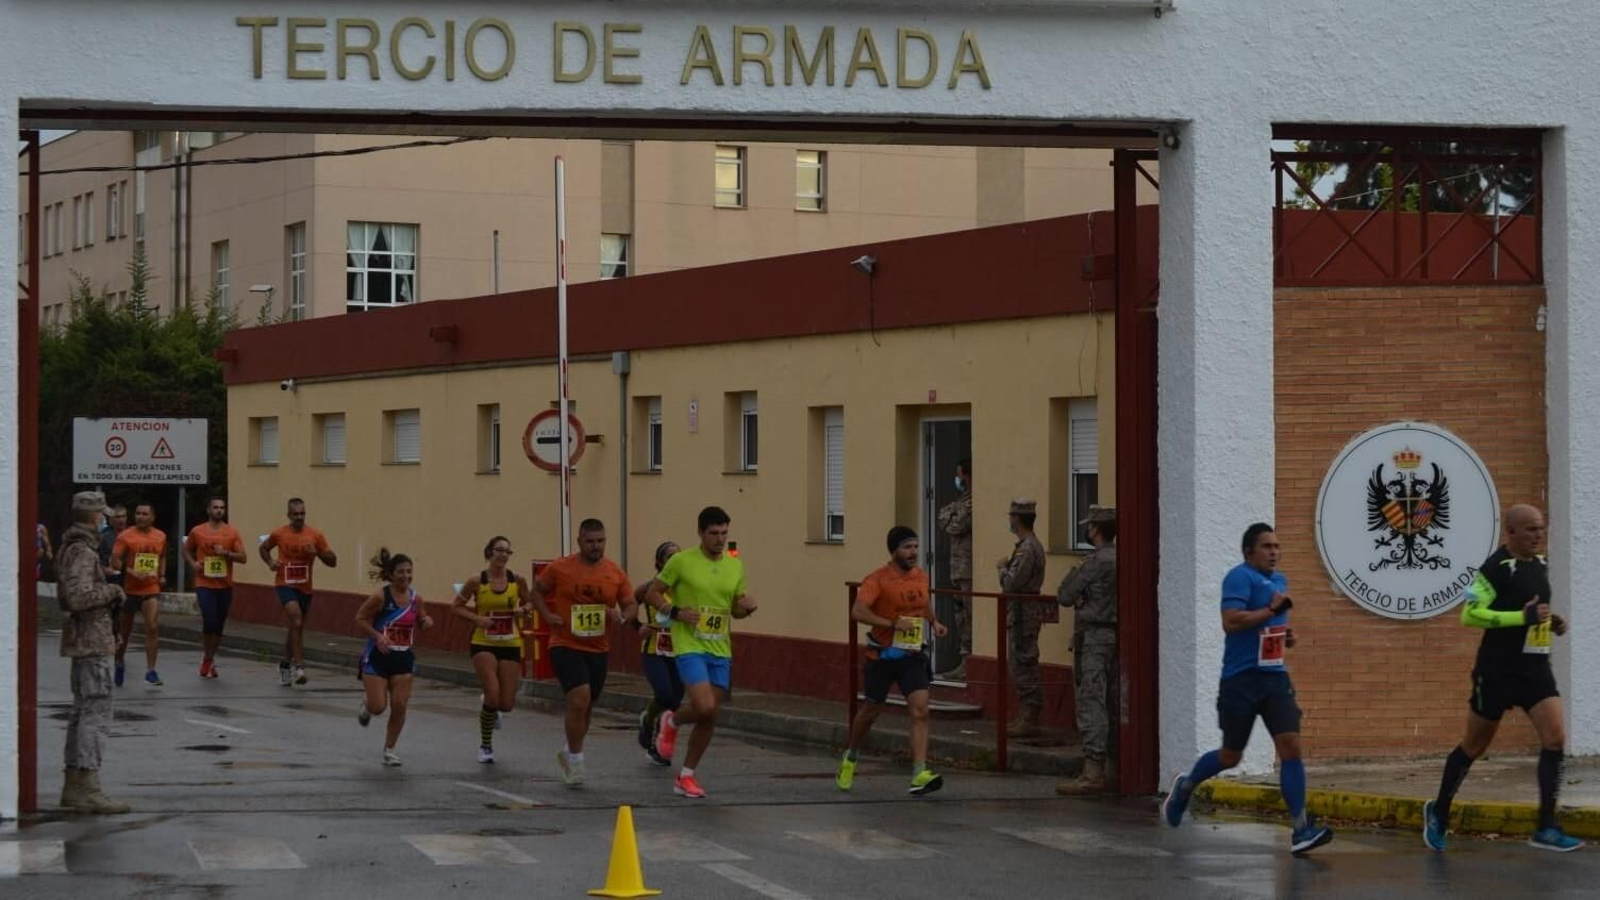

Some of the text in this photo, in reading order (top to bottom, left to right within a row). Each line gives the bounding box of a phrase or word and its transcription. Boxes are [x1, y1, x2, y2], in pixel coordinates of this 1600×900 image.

[236, 17, 992, 90] TERCIO DE ARMADA
[111, 422, 170, 431] ATENCION
[110, 443, 121, 452] 20
[98, 463, 138, 471] PRIORIDAD
[126, 473, 201, 481] ACUARTELAMIENTO
[139, 559, 154, 569] 140
[210, 561, 222, 571] 82
[1344, 565, 1478, 611] TERCIO DE ARMADA
[577, 612, 600, 627] 113
[706, 615, 722, 630] 48
